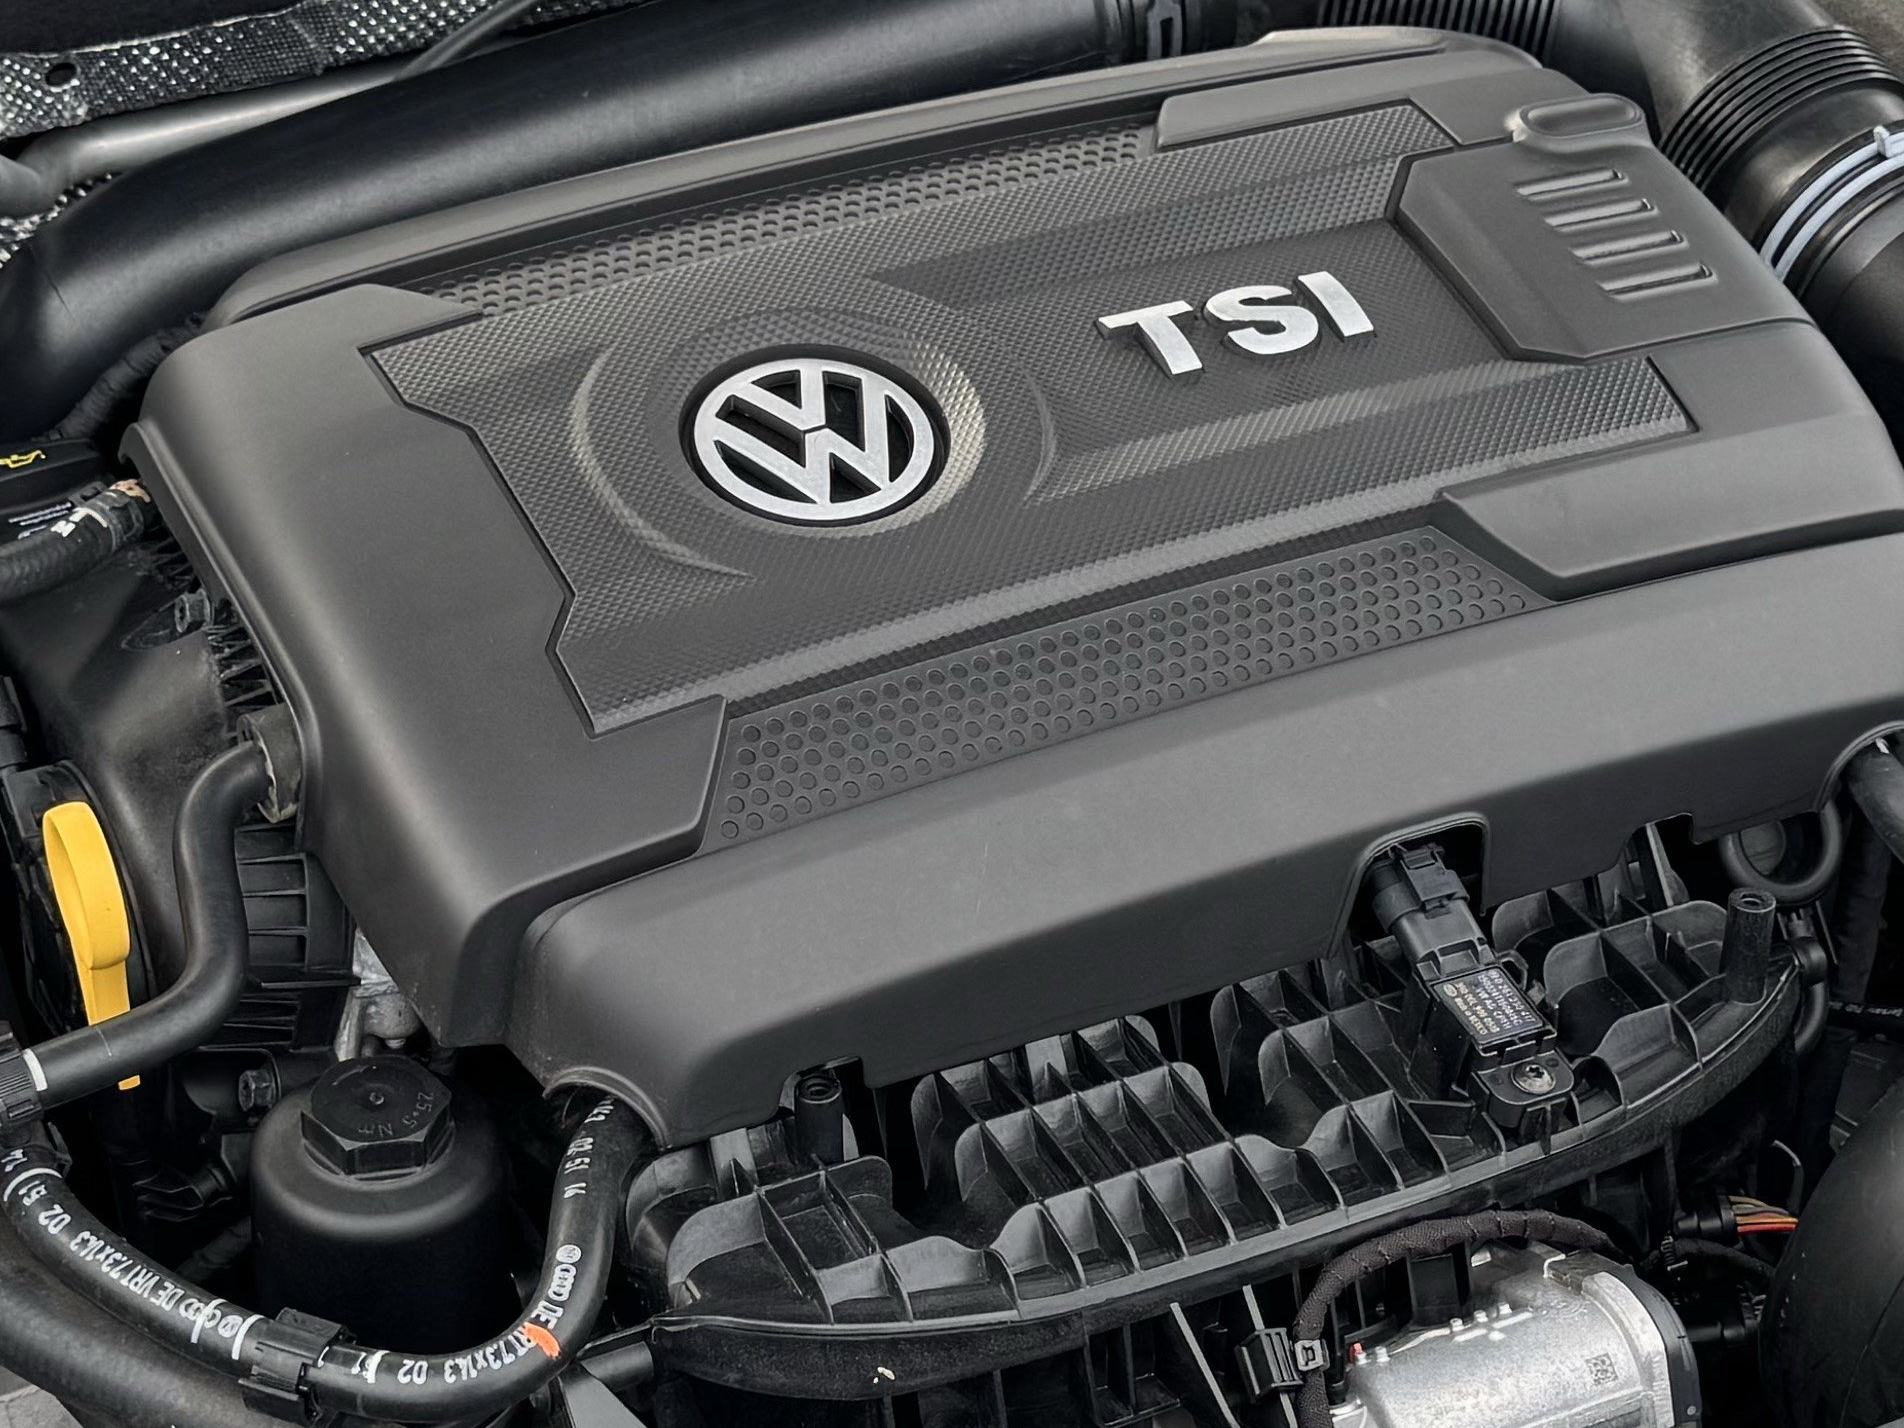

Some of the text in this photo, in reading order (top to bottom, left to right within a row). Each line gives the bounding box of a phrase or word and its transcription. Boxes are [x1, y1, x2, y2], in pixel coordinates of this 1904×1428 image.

[1099, 271, 1374, 378] TSI
[692, 356, 940, 524] VW
[18, 1180, 48, 1206] 51
[37, 1203, 72, 1235] 02
[150, 1281, 185, 1312] DE
[397, 1359, 429, 1385] 02
